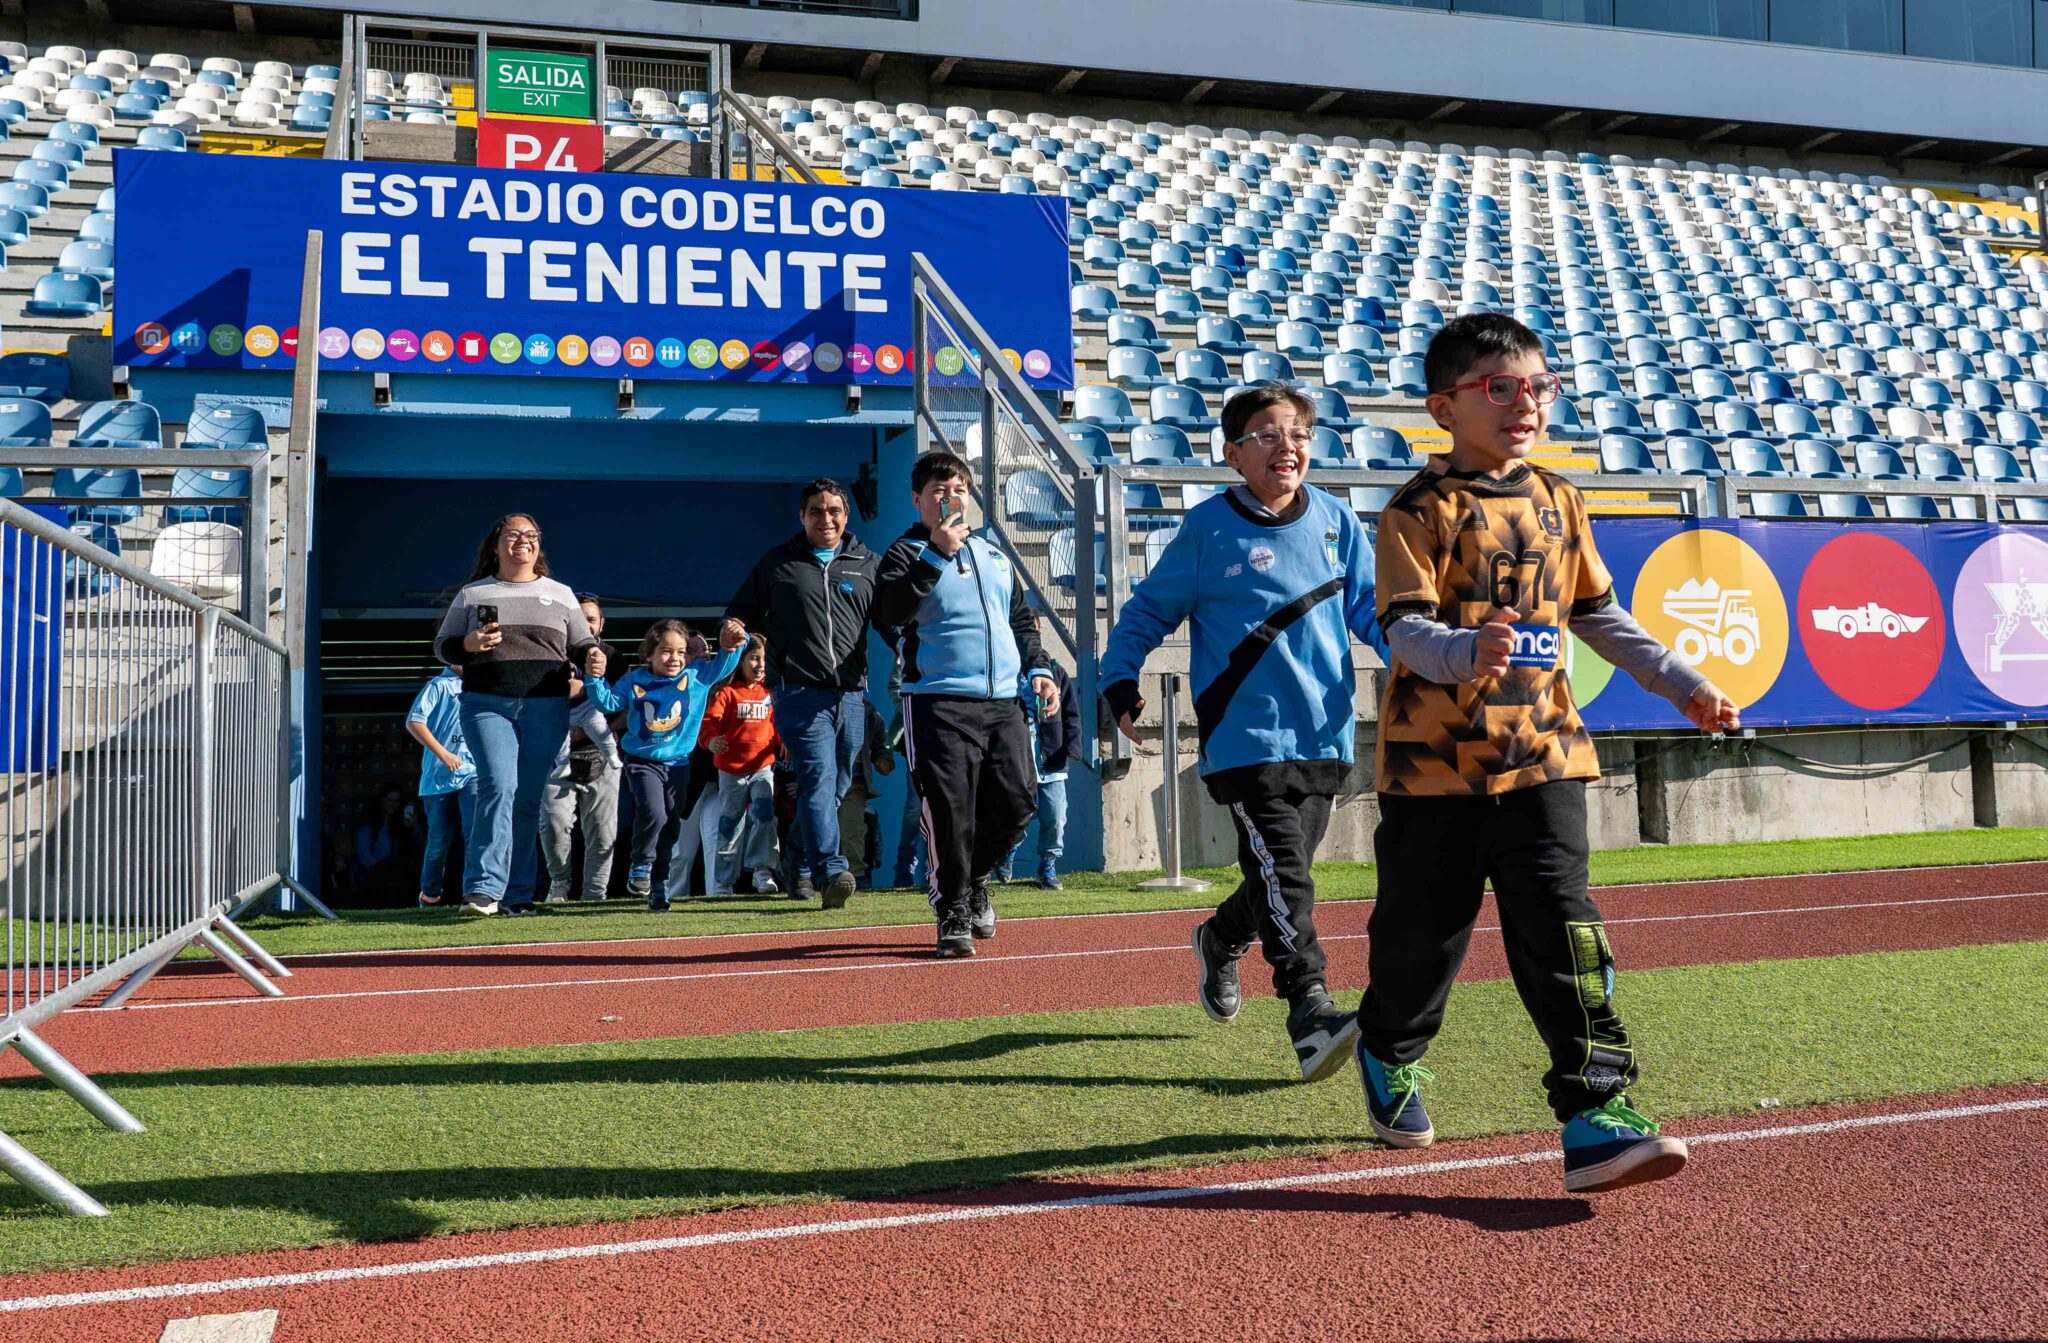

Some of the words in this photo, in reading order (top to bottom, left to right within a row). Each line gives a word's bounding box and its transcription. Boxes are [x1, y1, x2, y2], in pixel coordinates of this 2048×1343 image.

[498, 64, 586, 89] SALIDA
[523, 92, 561, 107] EXIT
[506, 133, 578, 172] P4
[341, 172, 604, 226] ESTADIO
[619, 186, 886, 239] CODELCO
[340, 232, 450, 298] EL
[468, 237, 888, 314] TENIENTE
[1488, 549, 1547, 611] 67
[1257, 844, 1280, 894] FASHON
